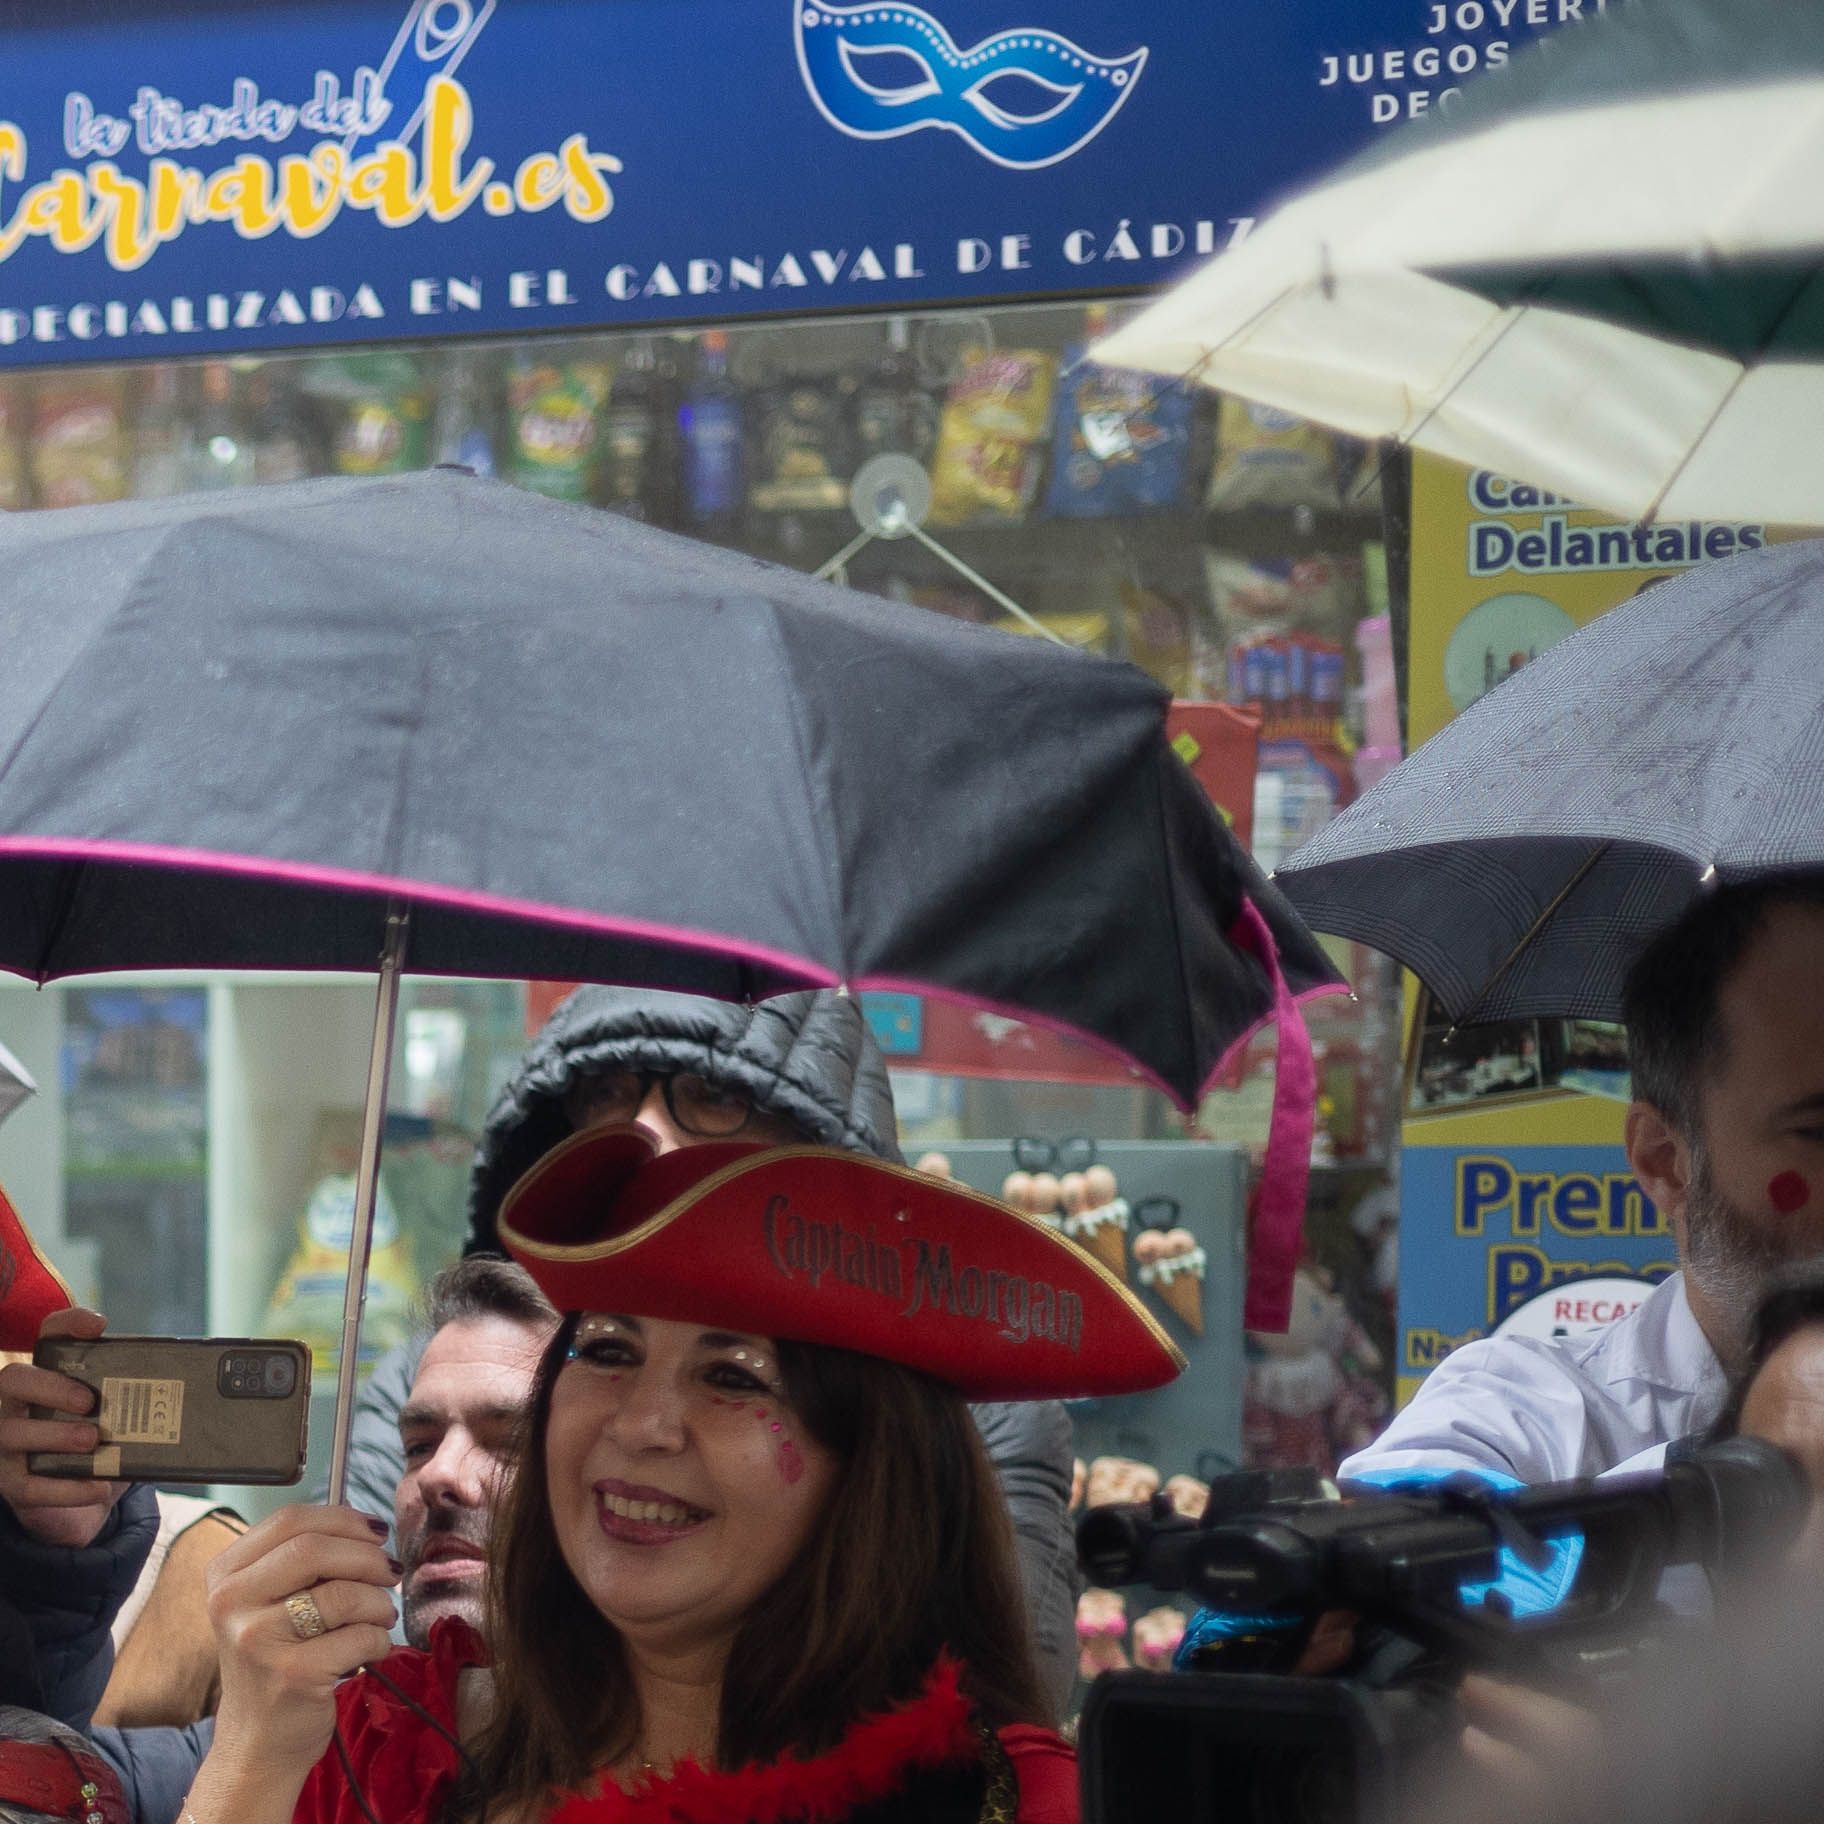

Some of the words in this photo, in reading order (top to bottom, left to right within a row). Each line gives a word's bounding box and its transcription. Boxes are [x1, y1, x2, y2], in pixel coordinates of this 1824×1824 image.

[1427, 0, 1608, 34] JOYER
[1318, 40, 1510, 86] JUEGOS
[63, 91, 132, 159] la
[128, 75, 299, 156] tienda
[299, 67, 392, 135] del
[408, 273, 485, 316] EN
[508, 267, 579, 309] EL
[604, 241, 927, 301] CARNAVAL
[956, 233, 1034, 275] DE
[1472, 519, 1765, 573] Delantales
[1459, 1159, 1662, 1233] Pren
[761, 1193, 904, 1299] Captain
[900, 1236, 1085, 1354] Morgan
